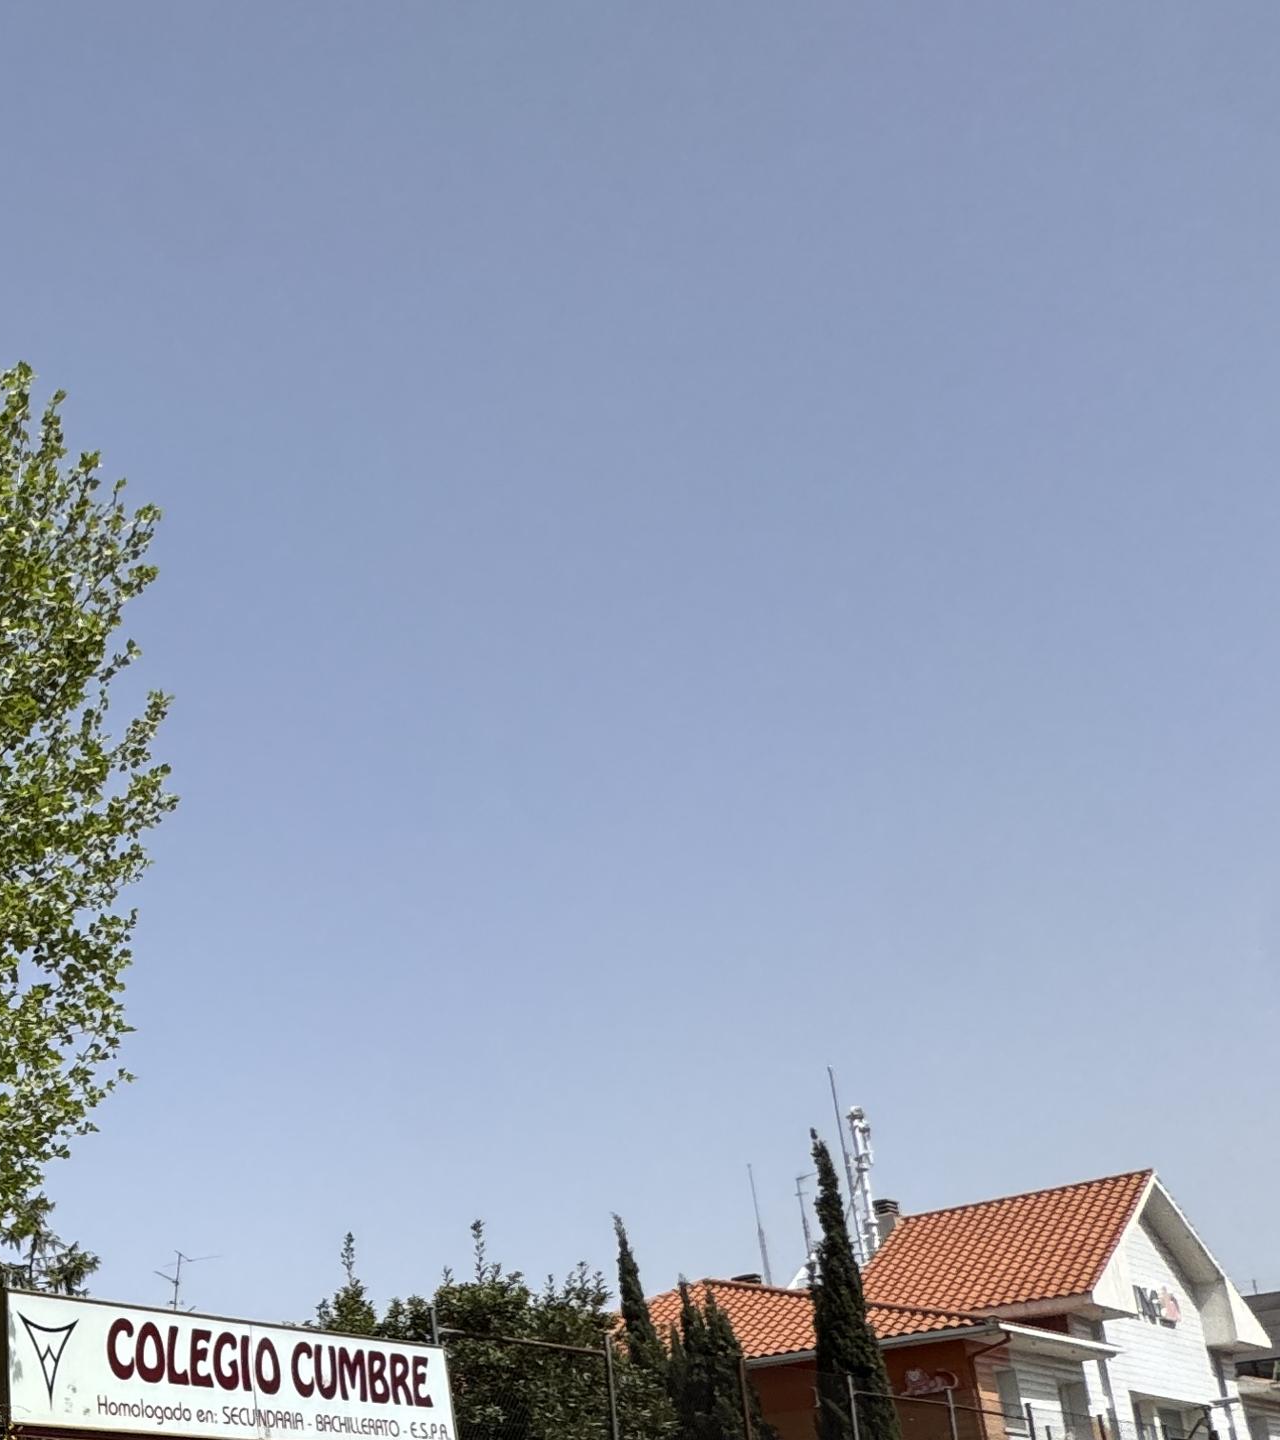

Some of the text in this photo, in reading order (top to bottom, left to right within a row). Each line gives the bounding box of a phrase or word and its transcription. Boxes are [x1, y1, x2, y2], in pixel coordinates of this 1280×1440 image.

[106, 1318, 433, 1408] COLEGIO CUMBRE
[97, 1395, 192, 1425] Homologado
[196, 1409, 218, 1424] en:
[222, 1406, 305, 1430] SECUNDARIA
[315, 1414, 400, 1437] BACHILLERATO
